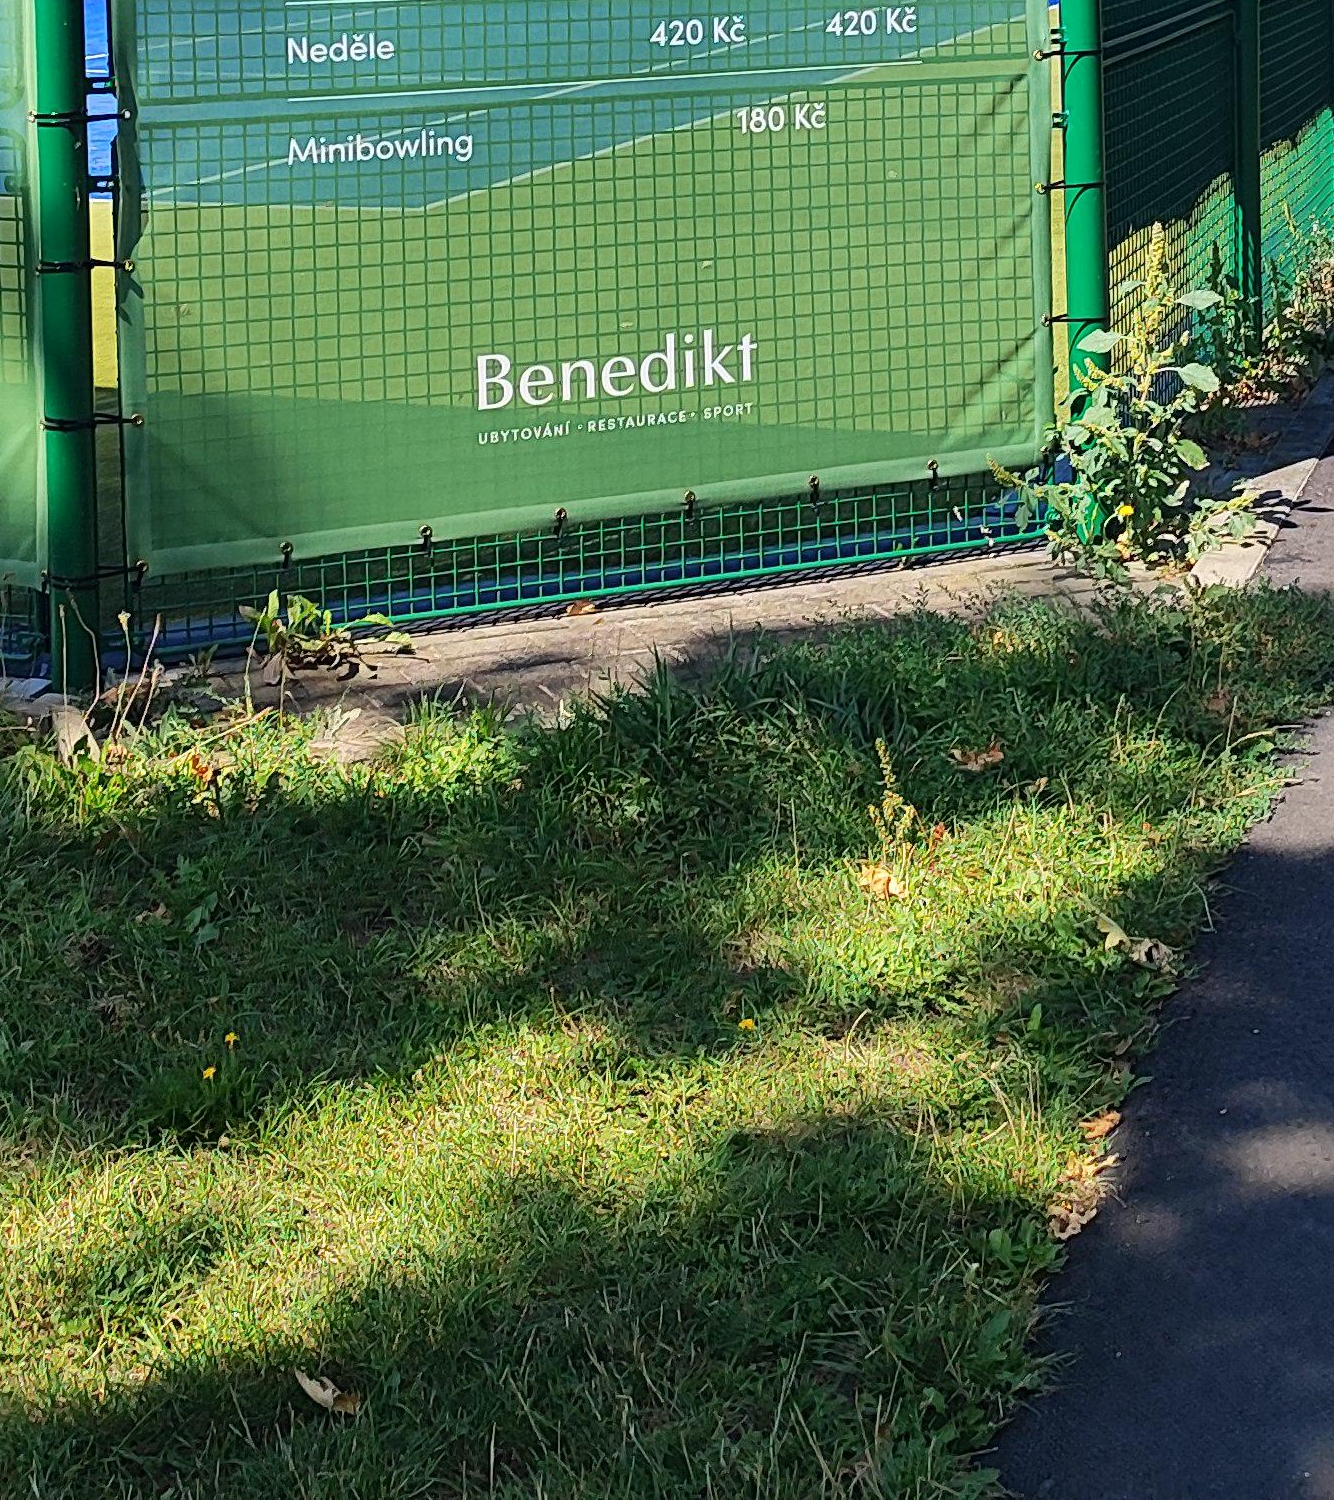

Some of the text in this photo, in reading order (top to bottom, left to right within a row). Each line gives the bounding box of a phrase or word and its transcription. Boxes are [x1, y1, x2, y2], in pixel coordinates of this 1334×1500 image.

[649, 16, 746, 48] 420 Kč
[826, 6, 917, 37] 420 Kč
[286, 34, 396, 66] Neděle
[737, 102, 826, 135] 180 Kč
[286, 129, 474, 166] Minibowling
[477, 329, 757, 411] Benedikt
[478, 402, 754, 445] UBYTOVÁNÍ RESTAURACE SPORT
